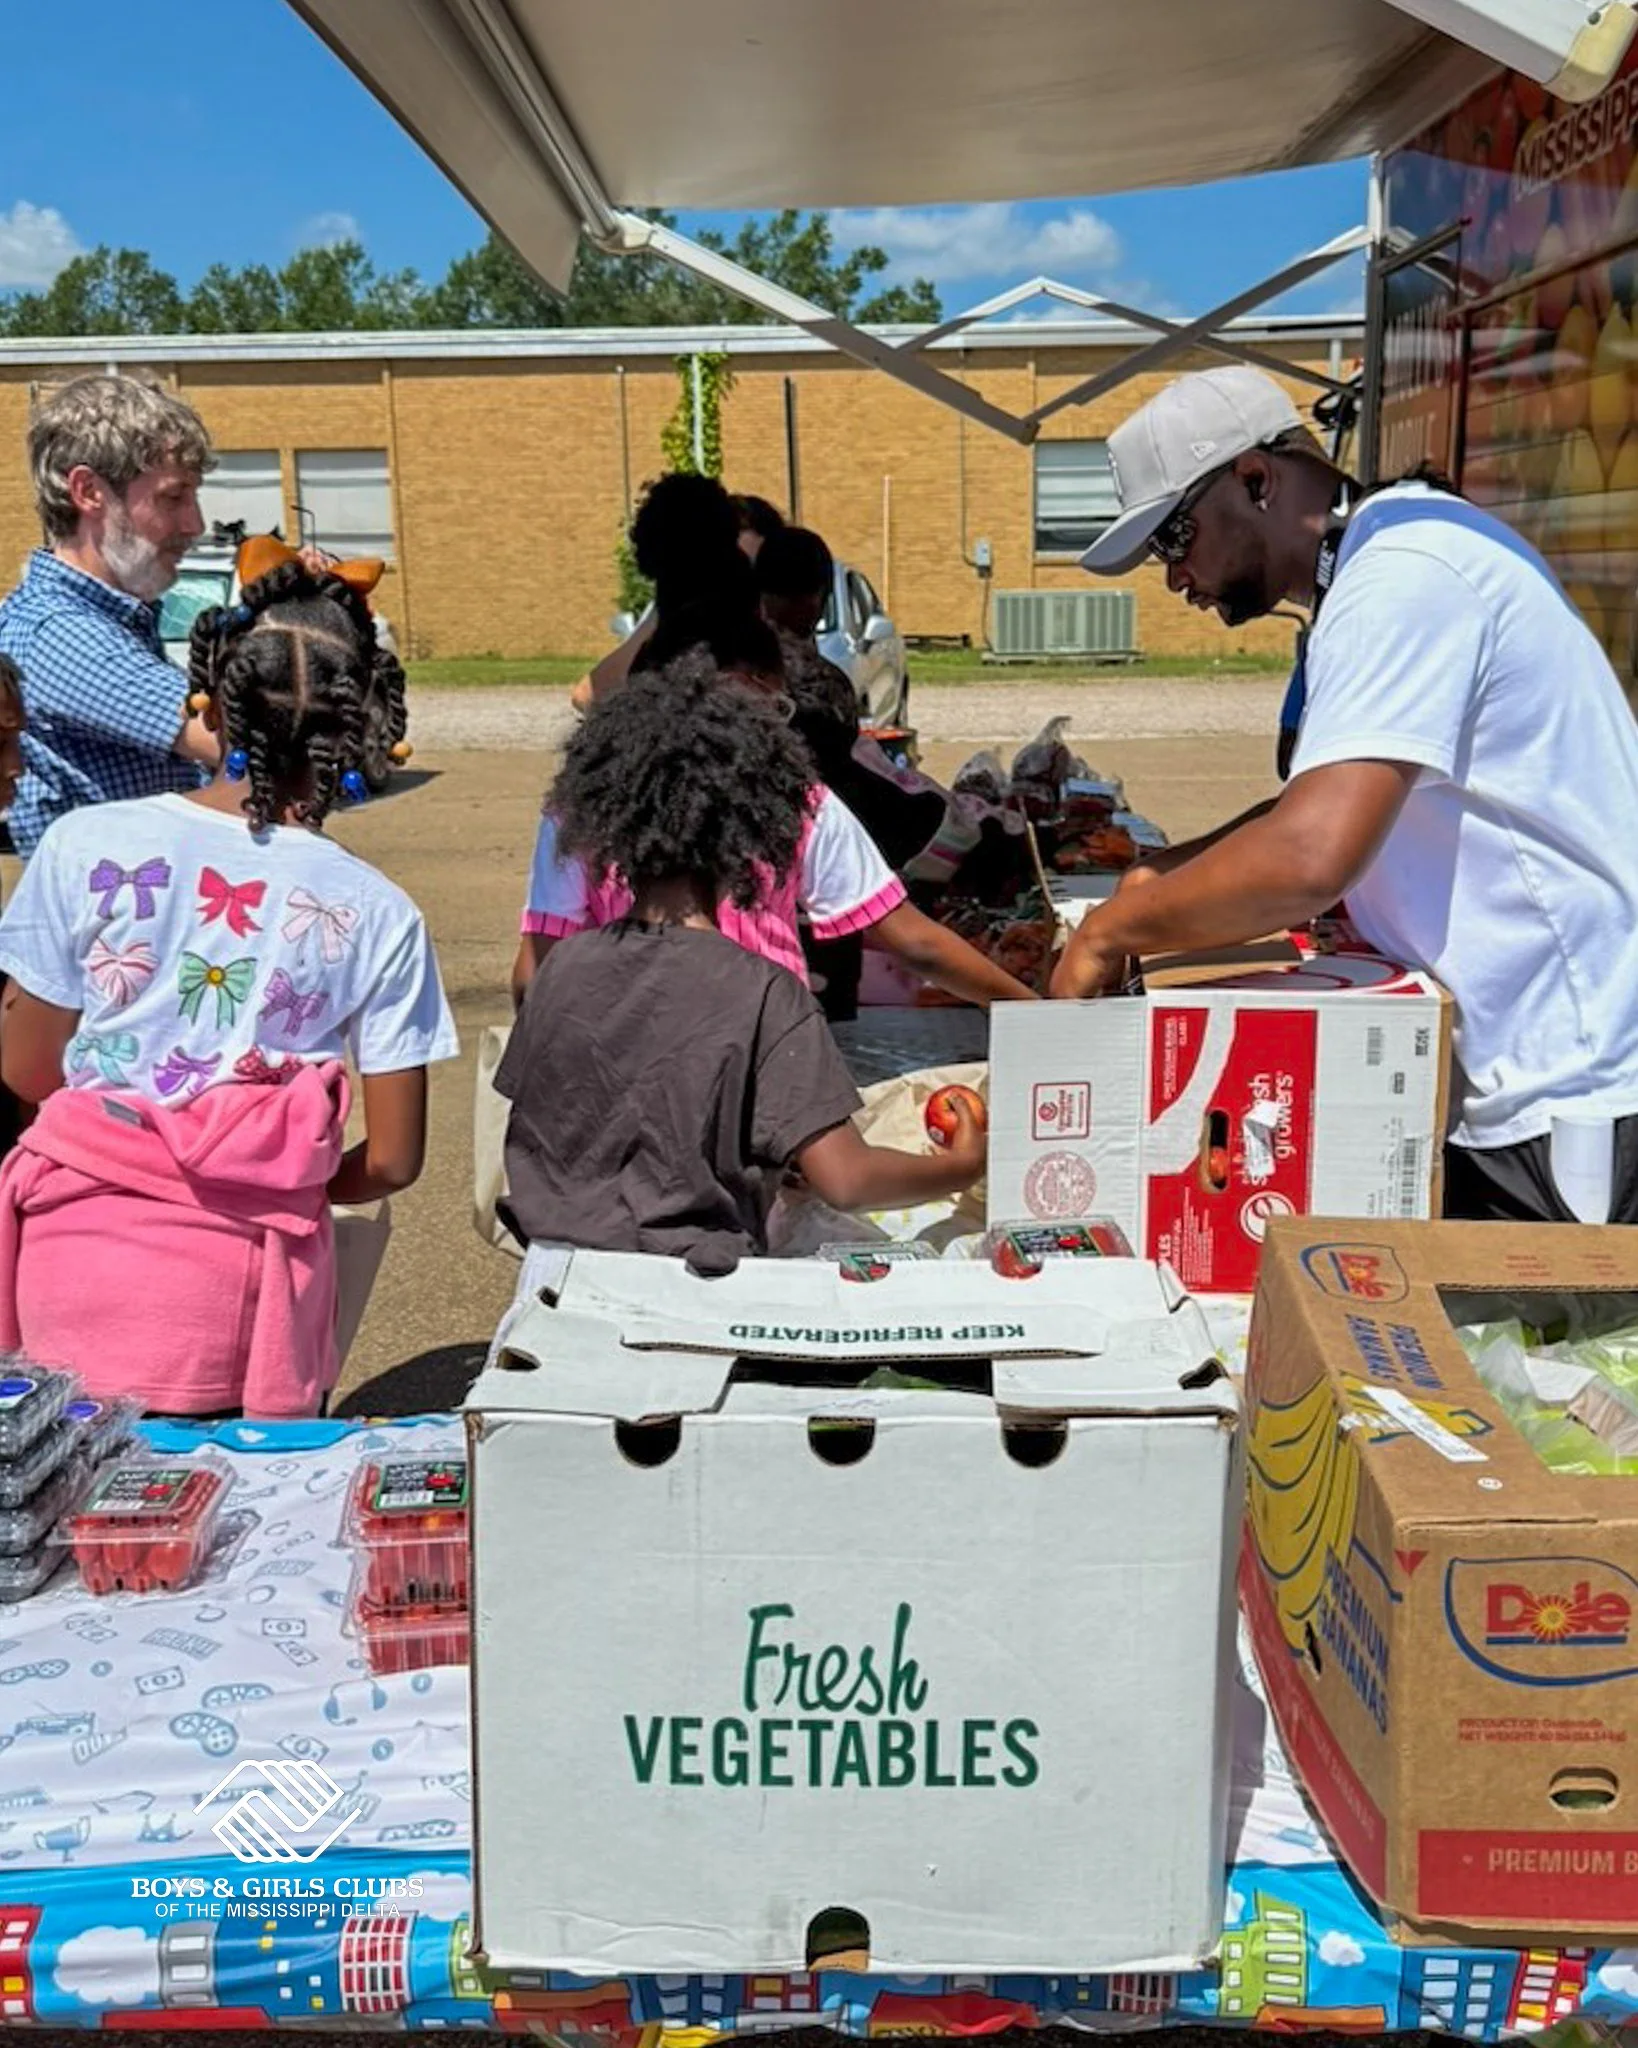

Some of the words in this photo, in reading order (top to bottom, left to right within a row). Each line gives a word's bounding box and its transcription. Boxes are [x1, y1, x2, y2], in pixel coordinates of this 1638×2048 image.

[1316, 550, 1335, 589] NIKE
[1275, 1074, 1295, 1160] growers
[1158, 1234, 1171, 1265] PLES
[728, 1324, 943, 1343] REFRIGERATED
[951, 1323, 1025, 1341] KEEP
[1486, 1582, 1630, 1638] Dole
[743, 1601, 929, 1716] Fresh
[623, 1714, 1040, 1788] VEGETABLES
[1488, 1847, 1615, 1875] PREMIUM
